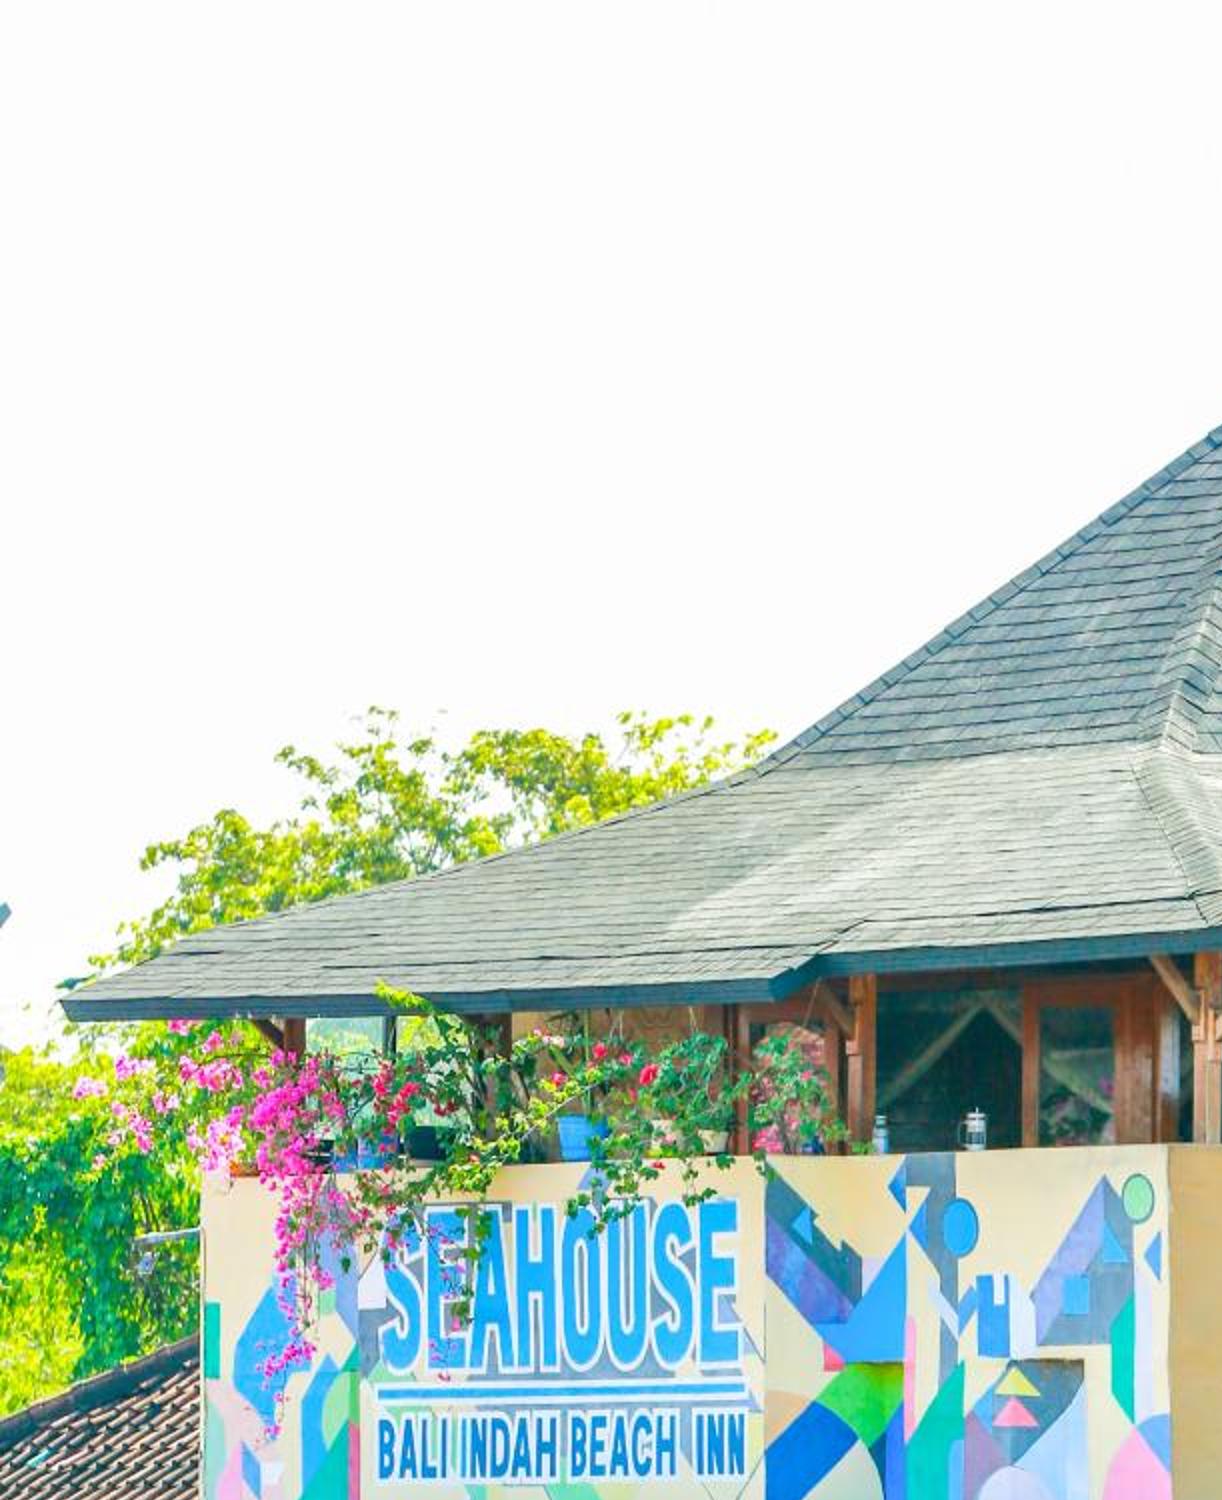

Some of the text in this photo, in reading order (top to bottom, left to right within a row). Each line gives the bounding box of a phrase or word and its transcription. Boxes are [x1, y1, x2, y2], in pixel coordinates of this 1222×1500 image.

[379, 1199, 741, 1372] SEAHOUSE
[378, 1412, 745, 1479] BALI INDAH BEACH INN
